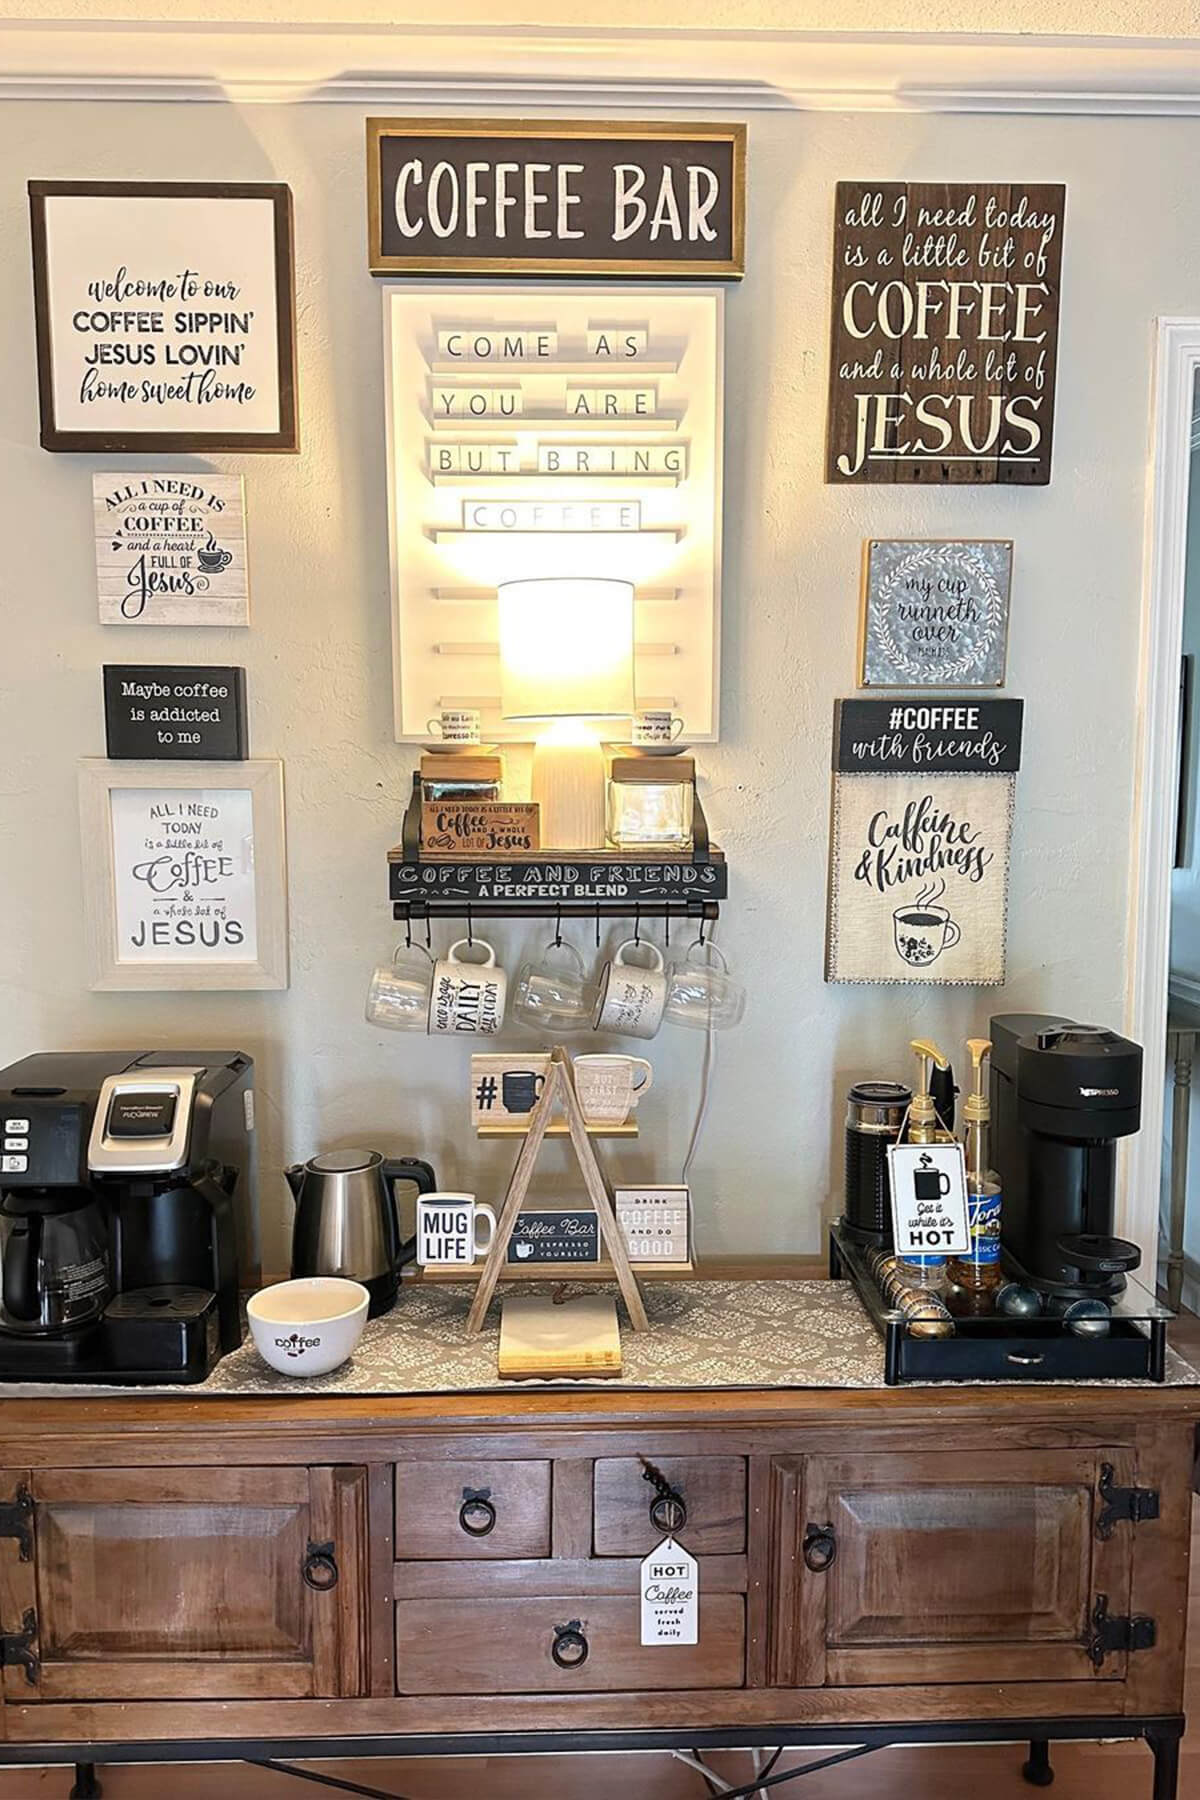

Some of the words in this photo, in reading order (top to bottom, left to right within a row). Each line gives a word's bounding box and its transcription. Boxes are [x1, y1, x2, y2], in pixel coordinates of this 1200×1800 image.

[395, 158, 585, 240] COFFEE
[612, 163, 720, 242] BAR
[845, 193, 884, 227] all
[892, 195, 907, 228] I
[917, 194, 976, 228] need
[985, 196, 1057, 242] today
[844, 245, 868, 267] is
[877, 249, 893, 266] a
[902, 233, 970, 267] little
[978, 233, 1015, 268] bit
[1024, 233, 1051, 277] of
[88, 266, 177, 302] welcome
[176, 269, 200, 302] to
[204, 280, 240, 300] our
[73, 311, 164, 333] COFFEE
[174, 311, 254, 334] SIPPIN'
[842, 279, 1050, 344] COFFEE
[84, 343, 155, 365] JESUS
[165, 344, 245, 366] LOVIN'
[446, 334, 550, 358] COME
[595, 334, 638, 357] AS
[839, 349, 883, 380] and
[890, 363, 903, 380] a
[911, 347, 977, 381] whole
[985, 349, 1018, 382] lot
[1025, 350, 1047, 391] of
[80, 367, 138, 403] home
[142, 371, 202, 402] sweet
[198, 368, 256, 404] home
[441, 394, 516, 416] YOU
[574, 393, 648, 415] ARE
[837, 392, 1044, 476] JESUS
[439, 449, 512, 472] BUT
[547, 450, 680, 473] BRING
[105, 486, 138, 512] ALL
[141, 481, 148, 494] I
[153, 479, 204, 500] NEED
[207, 495, 226, 512] IS
[138, 502, 146, 511] a
[149, 502, 169, 515] cup
[172, 499, 186, 515] of
[472, 506, 631, 529] COFFEE
[124, 516, 204, 532] COFFEE
[127, 539, 150, 551] and
[153, 542, 161, 550] a
[163, 538, 197, 551] heart
[151, 556, 177, 569] FULL
[180, 556, 193, 568] OF
[121, 554, 209, 619] Jesus
[905, 578, 934, 602] my
[937, 578, 969, 601] cup
[898, 597, 982, 622] runneth
[912, 625, 962, 643] over
[121, 682, 171, 700] Maybe
[174, 683, 228, 698] coffee
[130, 707, 145, 721] is
[150, 707, 221, 722] addicted
[889, 707, 980, 730] #COFFEE
[157, 731, 174, 743] to
[177, 732, 201, 743] me
[852, 732, 909, 761] with
[912, 731, 1007, 767] friends
[150, 803, 175, 819] ALL
[179, 803, 183, 815] I
[187, 804, 219, 819] NEED
[161, 822, 202, 834] TODAY
[437, 813, 488, 837] Coffee
[868, 795, 982, 854] Caffeine
[145, 838, 154, 849] is
[156, 841, 164, 849] a
[165, 839, 192, 849] little
[194, 839, 209, 849] bit
[211, 840, 224, 851] of
[462, 838, 474, 848] LOT
[486, 832, 531, 849] Jesus
[398, 866, 512, 883] COFFEE
[524, 865, 579, 882] AND
[590, 865, 716, 883] FRIENDS
[183, 890, 194, 902] &
[478, 886, 489, 897] A
[493, 885, 569, 897] PERFECT
[574, 885, 628, 897] BLEND
[163, 904, 193, 918] whole
[214, 907, 227, 921] of
[131, 920, 244, 947] JESUS
[437, 977, 456, 1029] encourage
[456, 980, 480, 1031] DAILY
[483, 981, 498, 1016] TODAY
[621, 1210, 681, 1225] COFFEE
[917, 1202, 934, 1216] Get
[936, 1203, 943, 1213] it
[424, 1213, 468, 1235] MUG
[512, 1219, 556, 1239] Coffee
[560, 1218, 595, 1235] Bar
[908, 1216, 937, 1228] while
[629, 1240, 673, 1256] GOOD
[910, 1230, 955, 1245] HOT
[426, 1238, 467, 1260] LIFE
[654, 1566, 685, 1577] HOT
[645, 1584, 693, 1605] Coffee
[655, 1607, 684, 1615] served
[658, 1629, 681, 1638] daily
